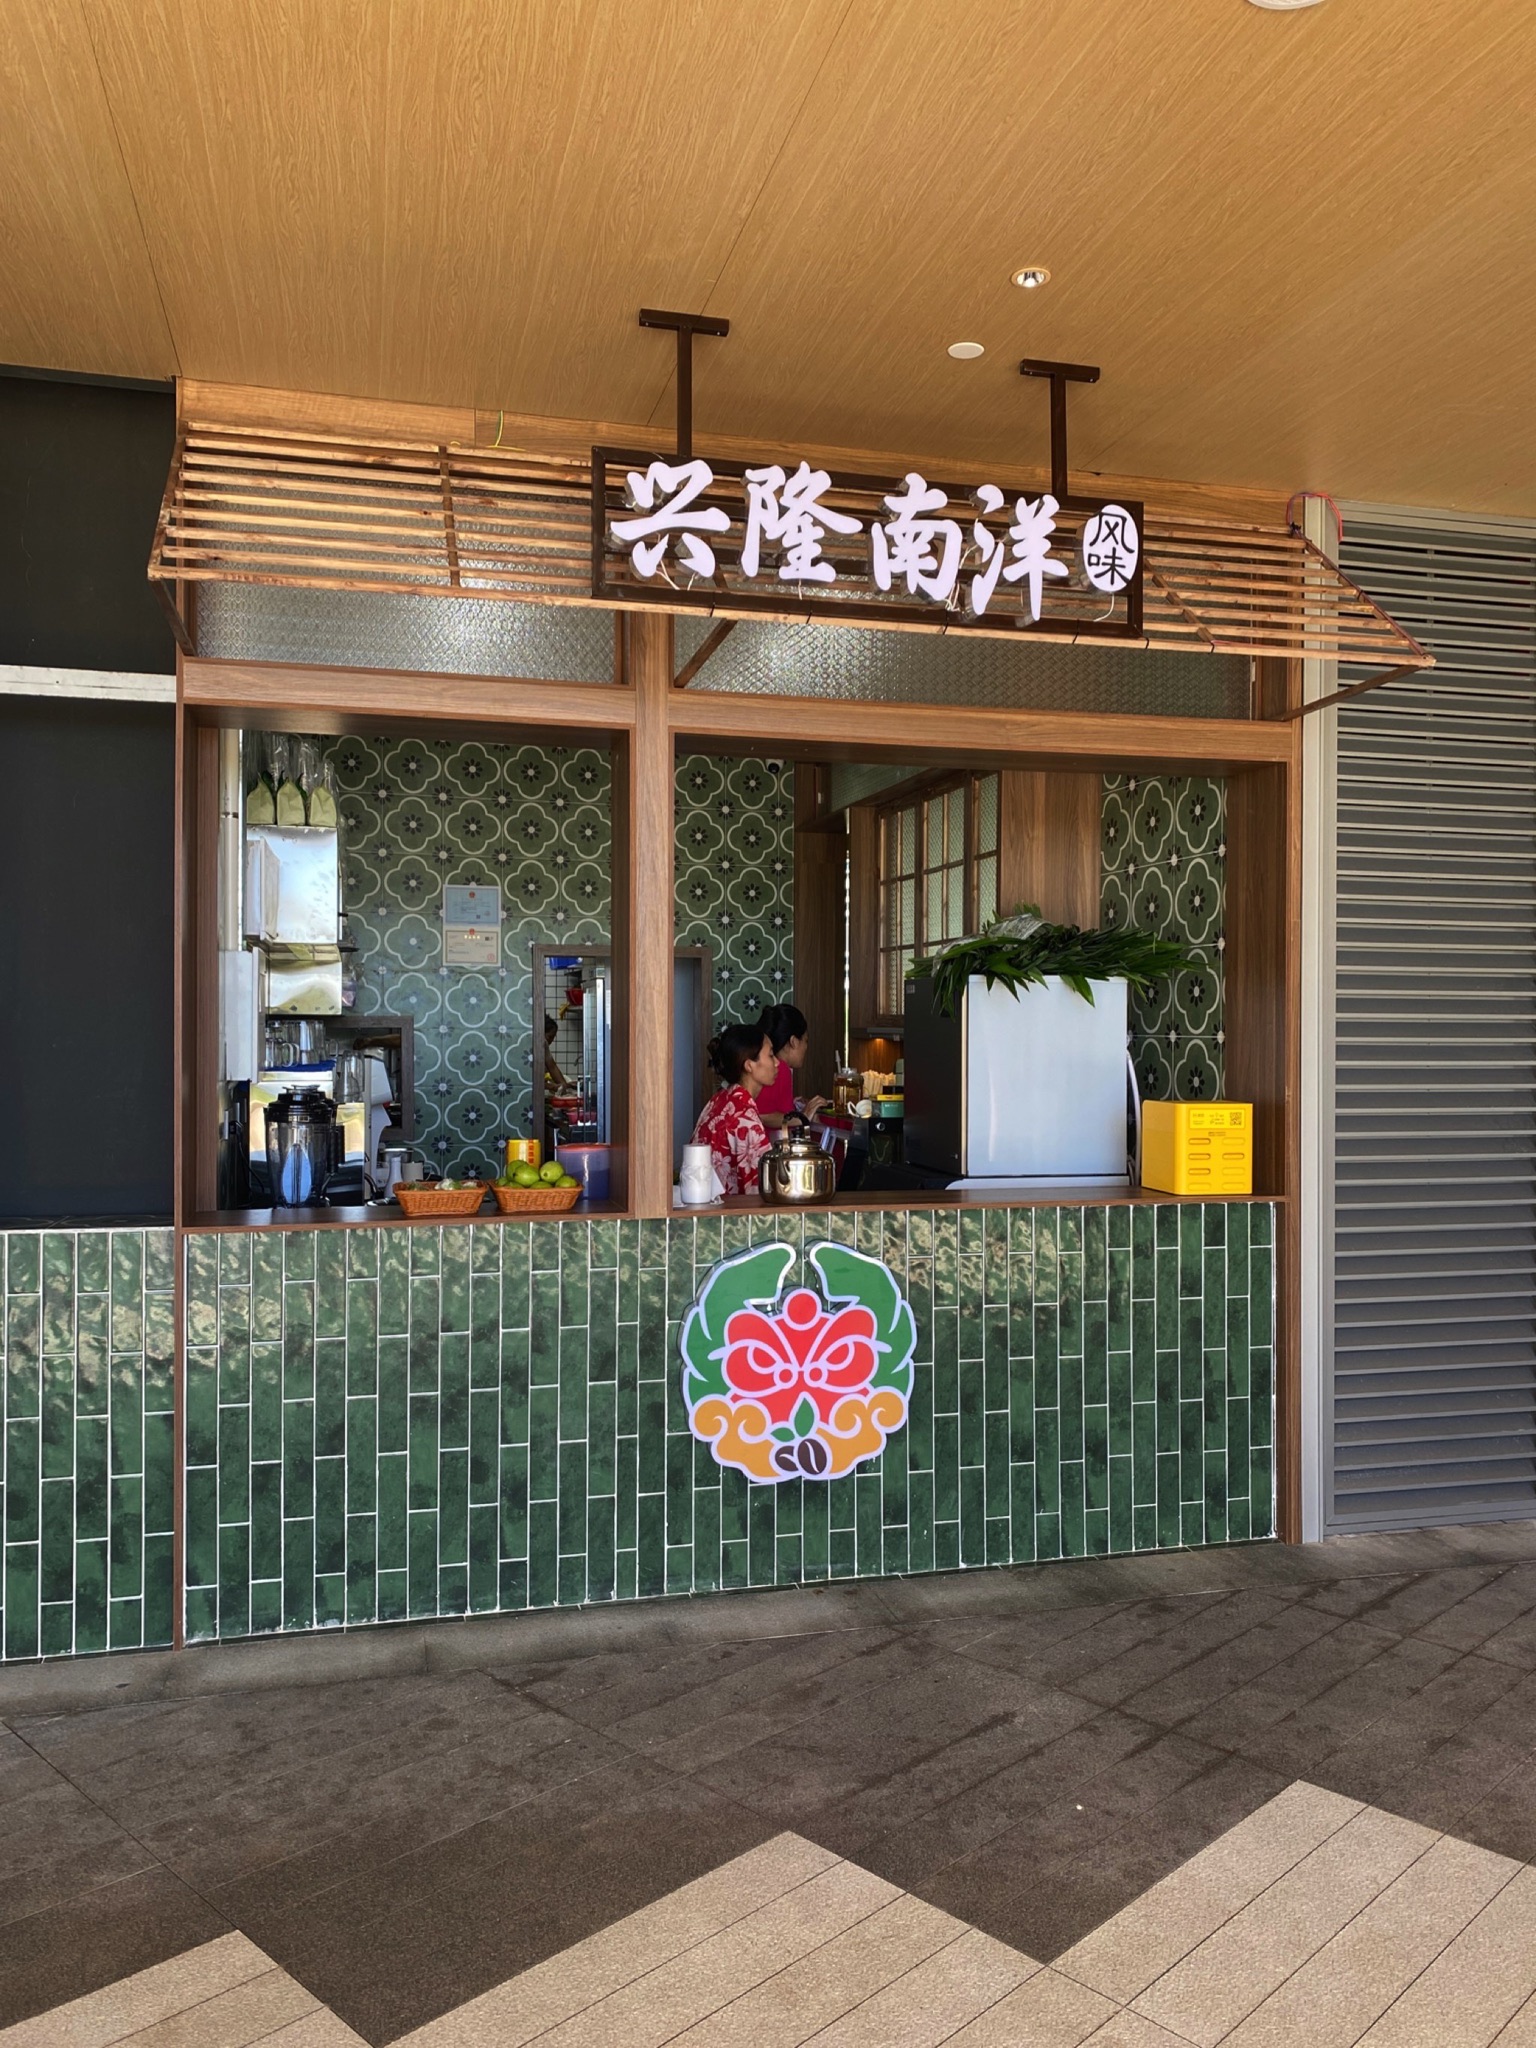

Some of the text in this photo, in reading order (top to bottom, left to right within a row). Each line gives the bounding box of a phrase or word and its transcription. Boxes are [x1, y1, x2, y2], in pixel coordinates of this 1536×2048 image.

[610, 460, 1069, 621] 兴隆南洋
[1087, 511, 1135, 586] 风味
